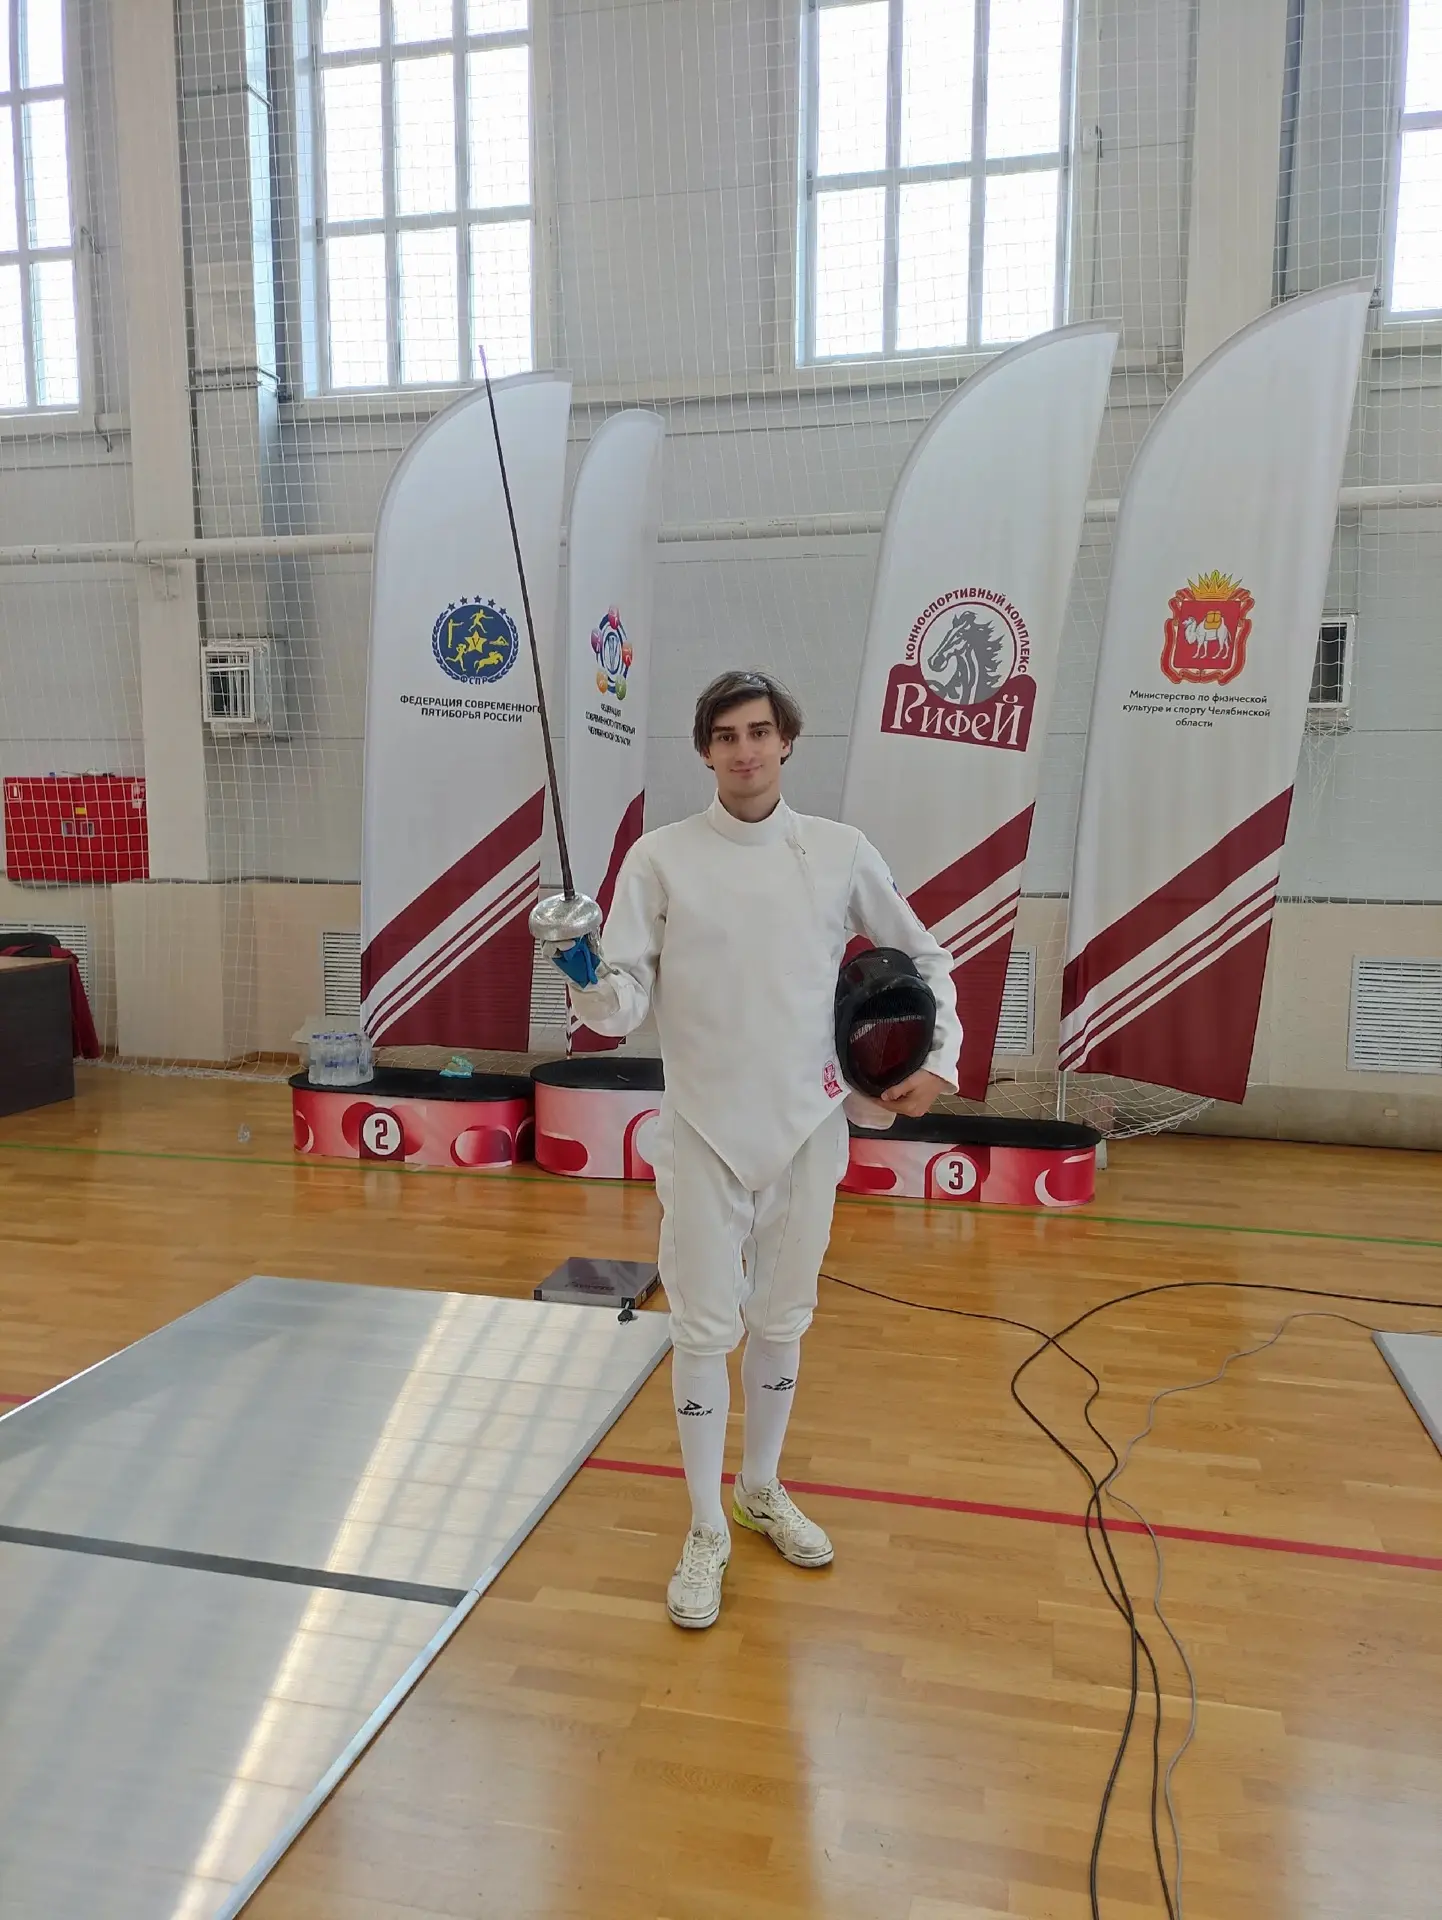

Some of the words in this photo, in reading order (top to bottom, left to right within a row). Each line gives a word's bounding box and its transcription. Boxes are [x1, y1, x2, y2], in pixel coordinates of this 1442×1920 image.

[905, 587, 1006, 661] КОННОСПОРТИВНЫЙ
[1004, 602, 1030, 674] КОМПЛЕКС
[459, 674, 488, 685] ФСПР
[400, 694, 463, 707] ФЕДЕРАЦИЯ
[1129, 689, 1196, 704] Министерство
[1197, 694, 1210, 703] по
[1212, 693, 1268, 706] физической
[421, 707, 481, 719] ПЯТИБОРЬЯ
[483, 711, 523, 723] РОССИИ
[1122, 704, 1164, 714] культуре
[1173, 706, 1207, 717] спорту
[1208, 706, 1271, 718] Челябинской
[1175, 718, 1213, 728] области
[374, 1118, 389, 1150] 2
[948, 1160, 964, 1190] 3
